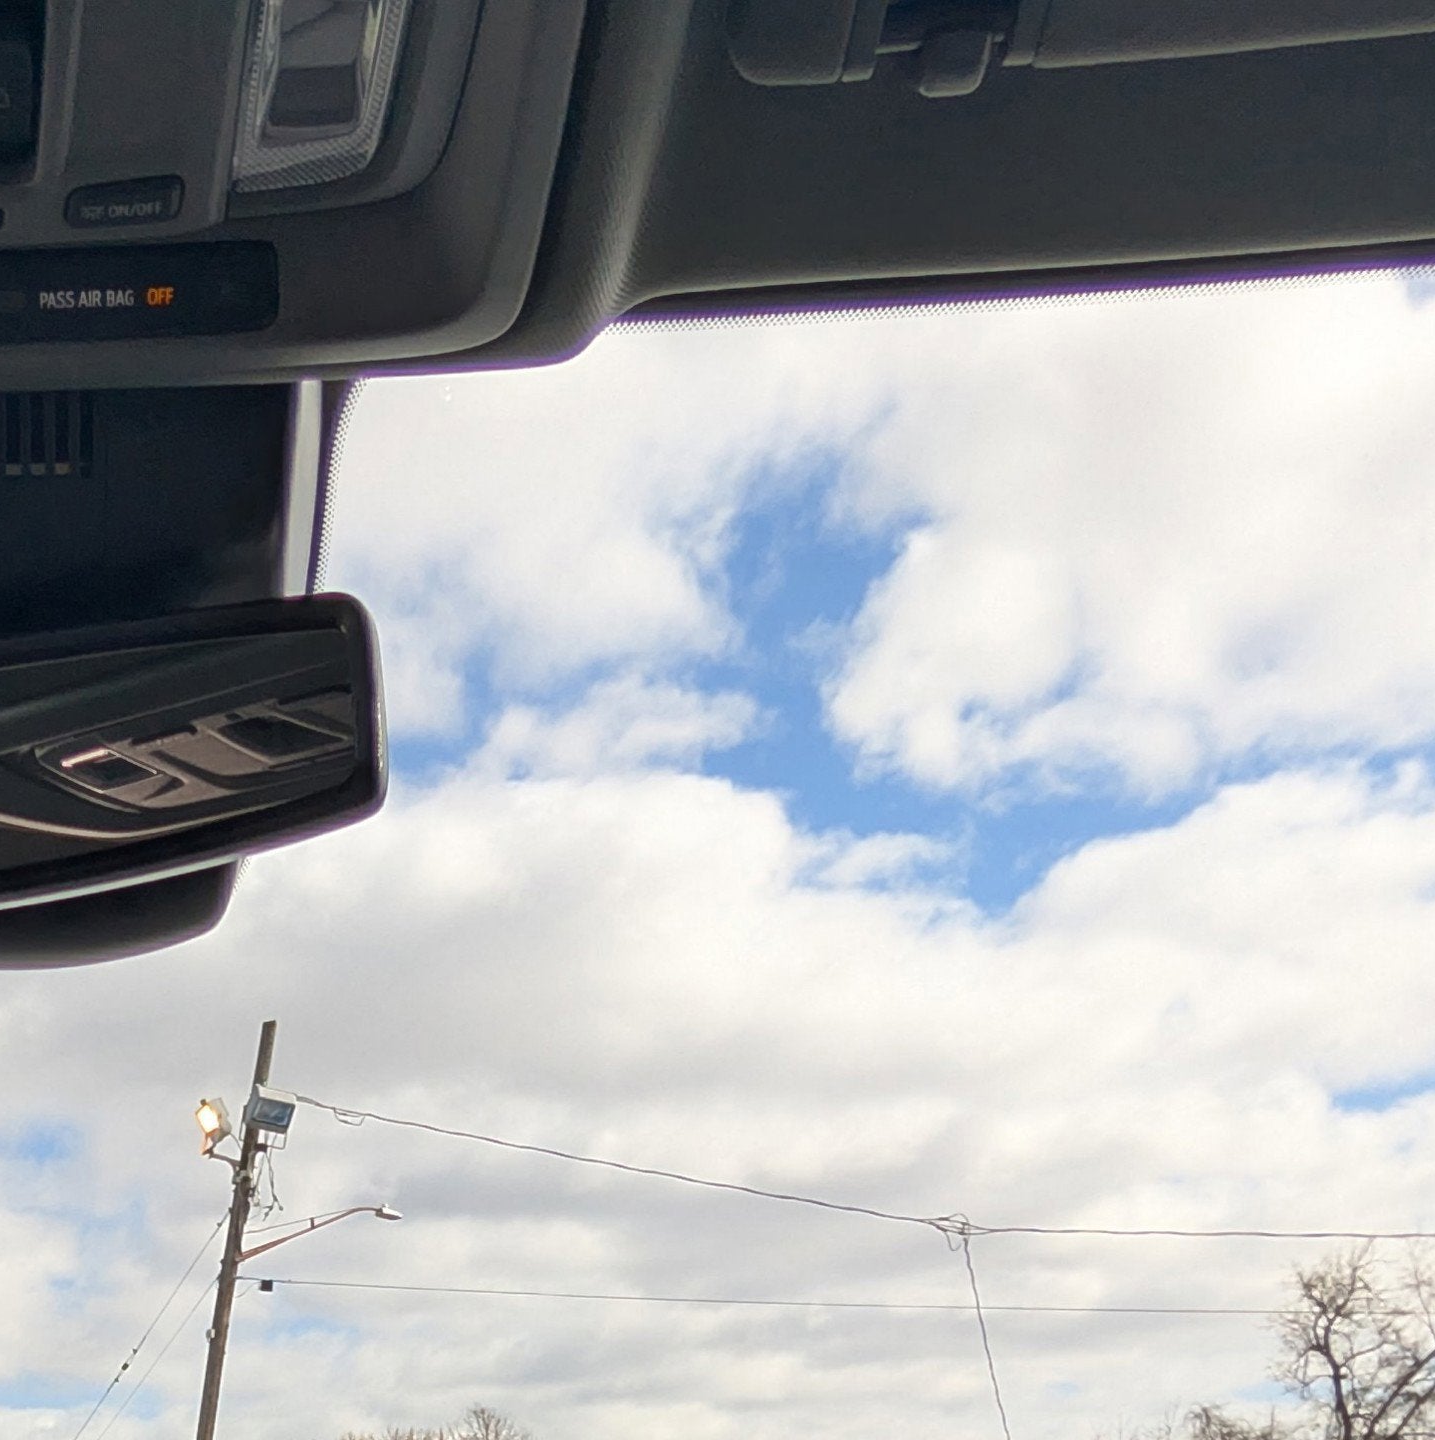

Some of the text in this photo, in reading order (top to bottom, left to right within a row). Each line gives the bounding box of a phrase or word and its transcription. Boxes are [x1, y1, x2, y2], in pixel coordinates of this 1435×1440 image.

[39, 287, 175, 309] PASS AIR BAG OFF
